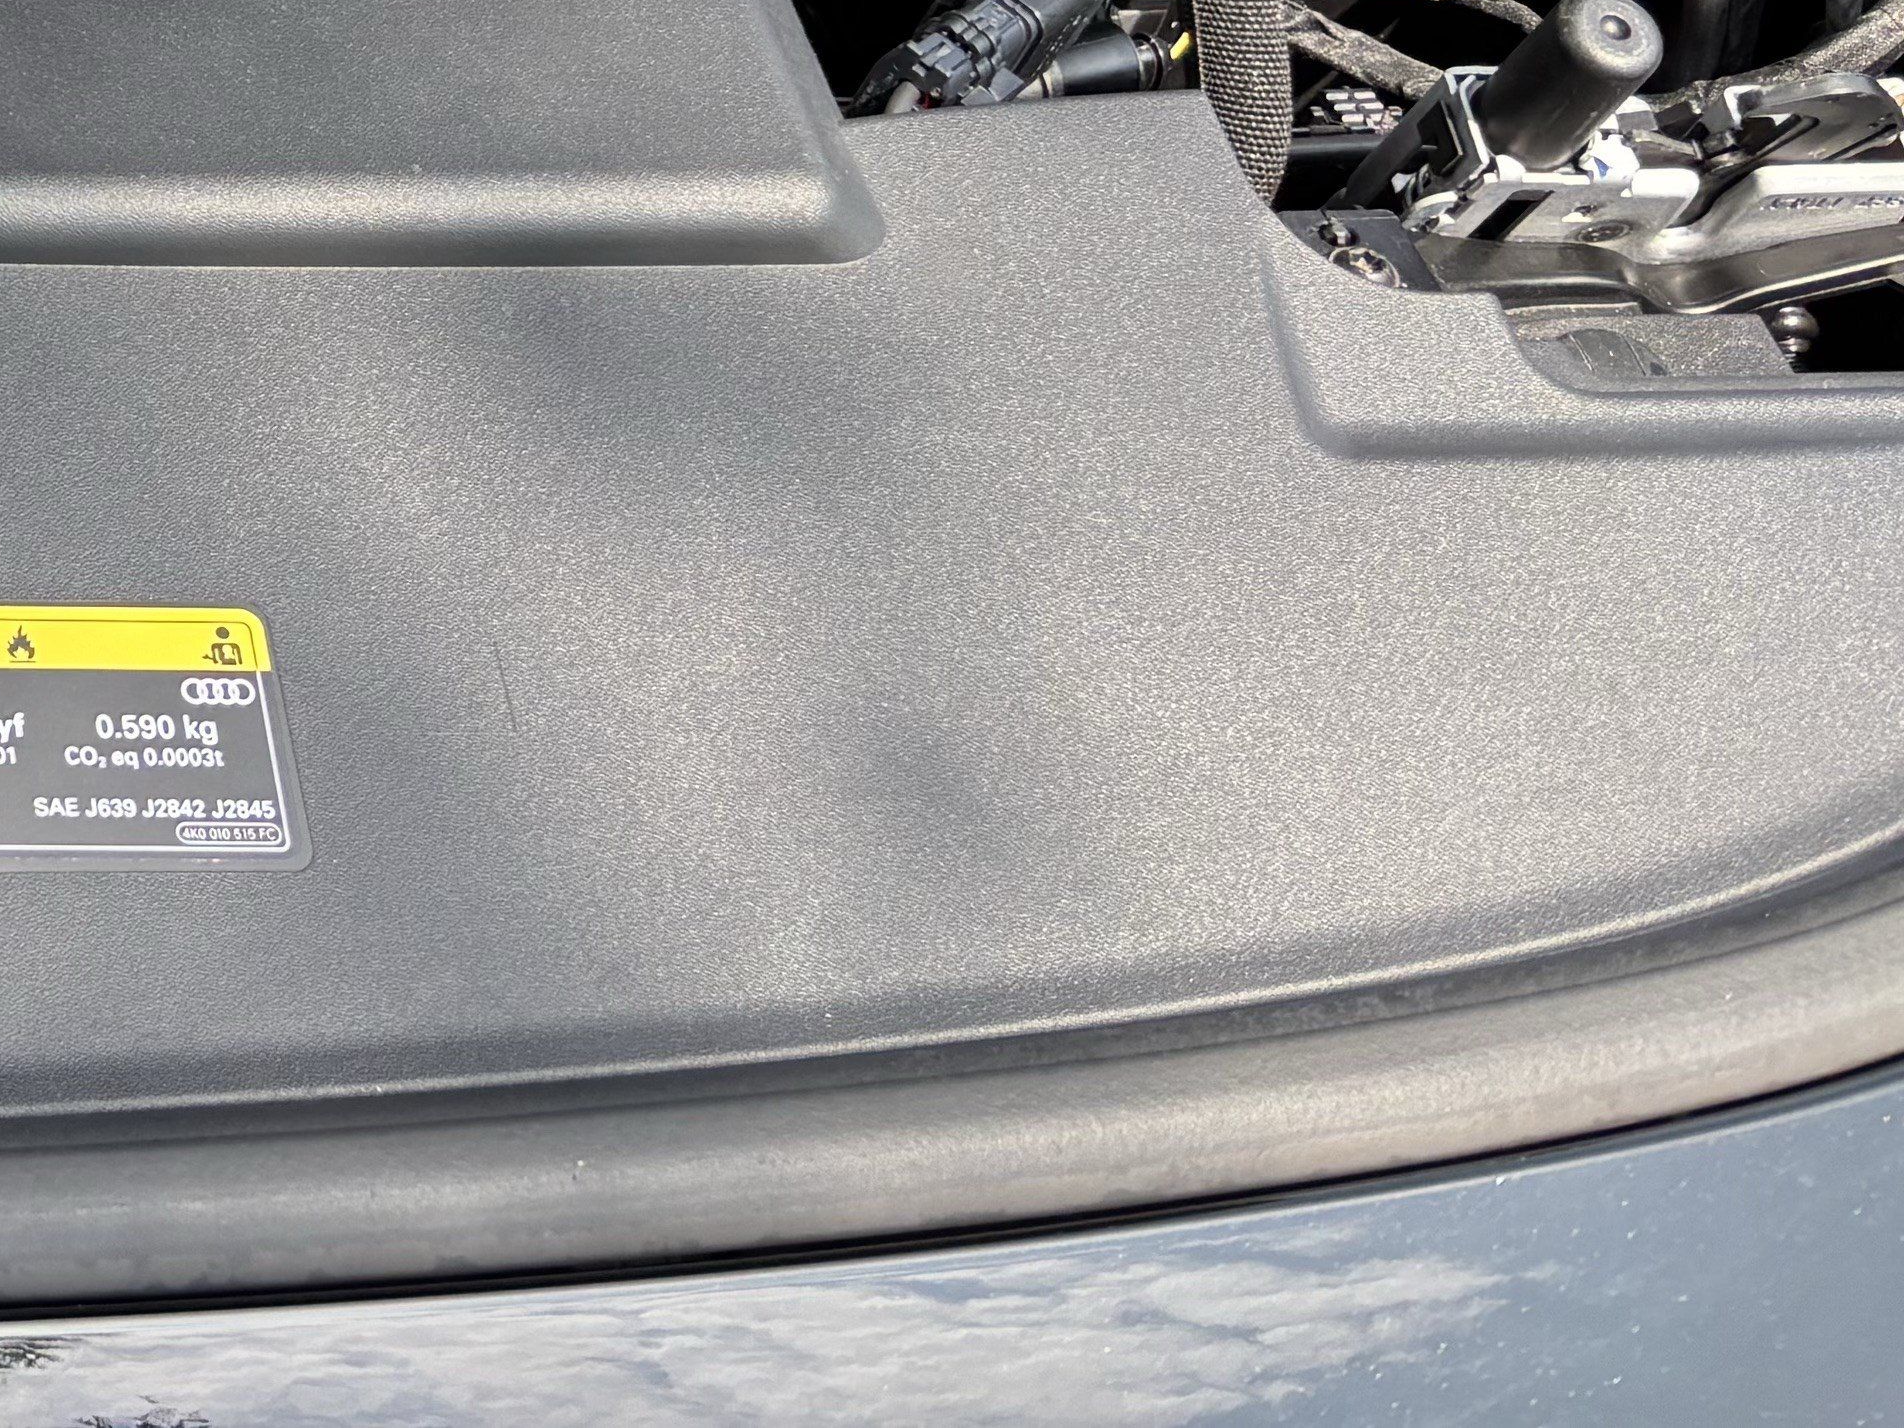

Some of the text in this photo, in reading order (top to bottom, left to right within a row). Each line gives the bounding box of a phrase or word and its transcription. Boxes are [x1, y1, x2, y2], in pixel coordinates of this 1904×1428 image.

[94, 713, 219, 746] 0.590 kg
[111, 751, 139, 769] eq
[143, 747, 225, 767] 0.0003t
[33, 797, 276, 819] SAE J639 J2842 J2845
